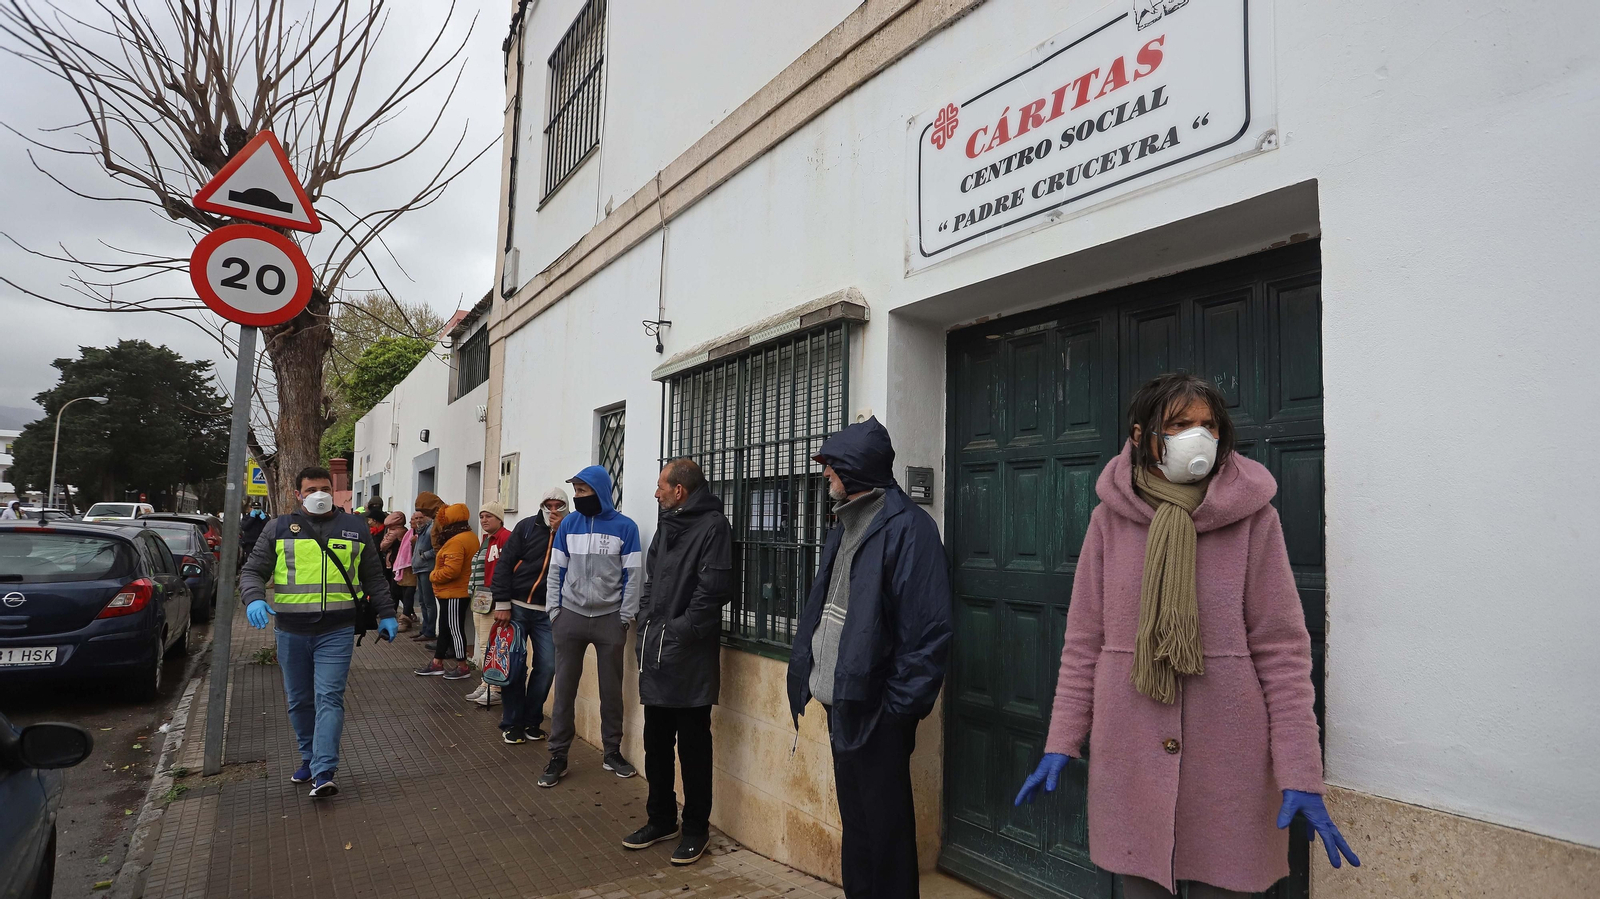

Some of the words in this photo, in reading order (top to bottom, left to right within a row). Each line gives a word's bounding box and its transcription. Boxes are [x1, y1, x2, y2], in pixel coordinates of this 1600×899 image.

[960, 138, 1052, 193] CENTRO
[1059, 85, 1169, 151] SOCIAL
[965, 34, 1165, 159] CÁRITAS
[952, 188, 1025, 233] PADRE
[1031, 126, 1180, 199] CRUCEYRA
[220, 257, 286, 296] 20
[21, 649, 54, 661] HSK
